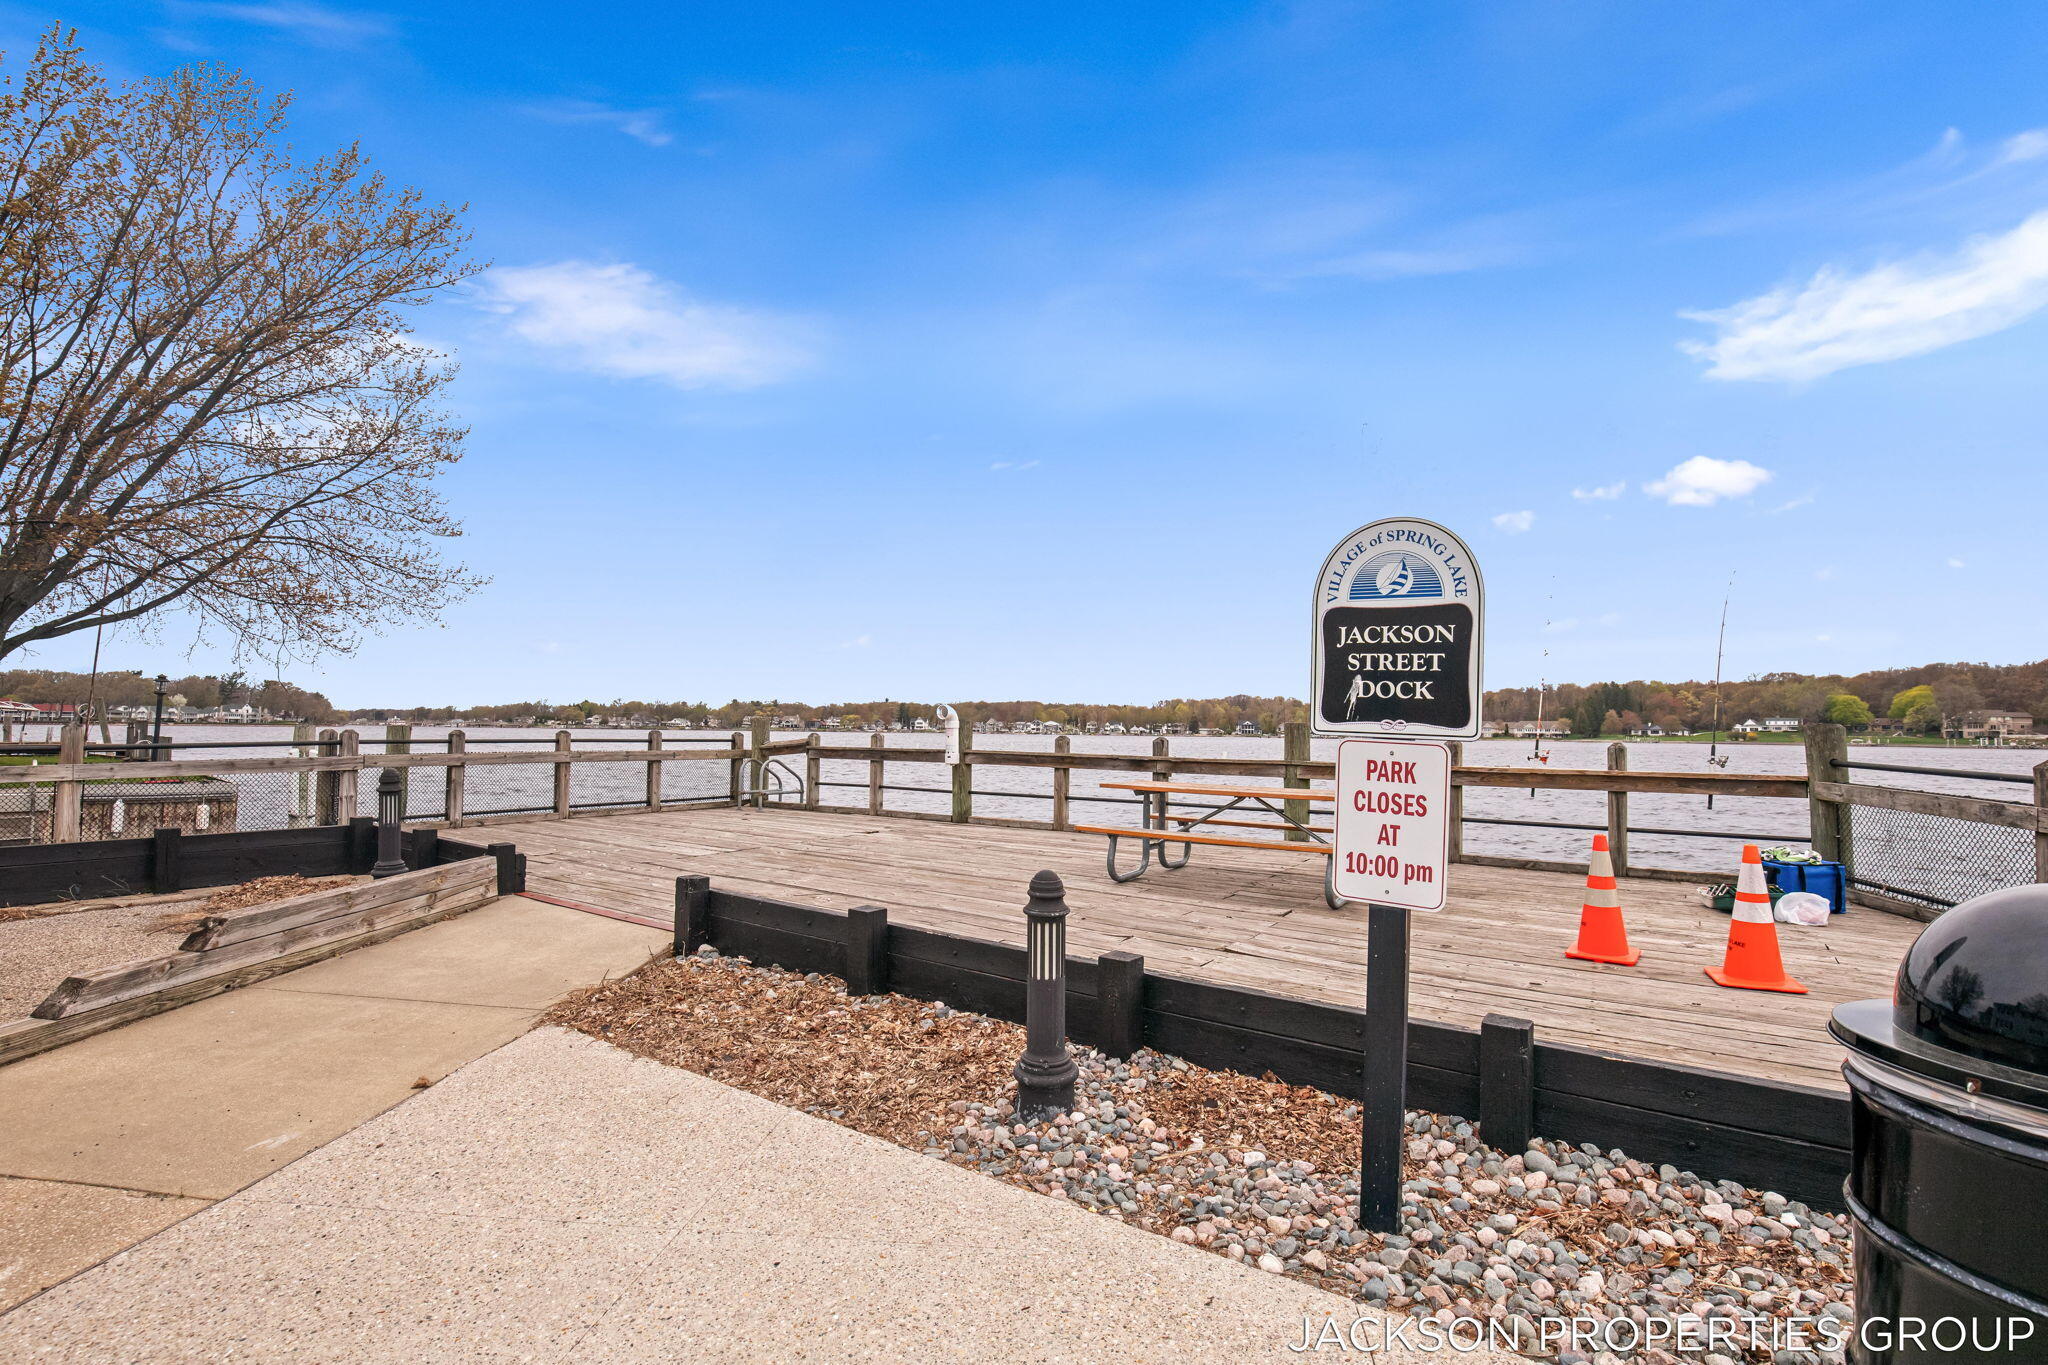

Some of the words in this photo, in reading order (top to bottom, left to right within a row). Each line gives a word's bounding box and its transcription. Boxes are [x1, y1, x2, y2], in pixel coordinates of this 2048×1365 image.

[1327, 541, 1367, 603] VILLAGE
[1369, 532, 1383, 548] of
[1386, 529, 1447, 556] SPRING
[1443, 554, 1468, 598] LAKE
[1337, 624, 1456, 648] JACKSON
[1347, 653, 1445, 672] STREET
[1357, 680, 1434, 700] DOCK
[1366, 759, 1417, 784] PARK
[1354, 790, 1427, 817] CLOSES
[1377, 823, 1400, 847] AT
[1346, 851, 1398, 879] 10:00
[1404, 863, 1433, 885] pm
